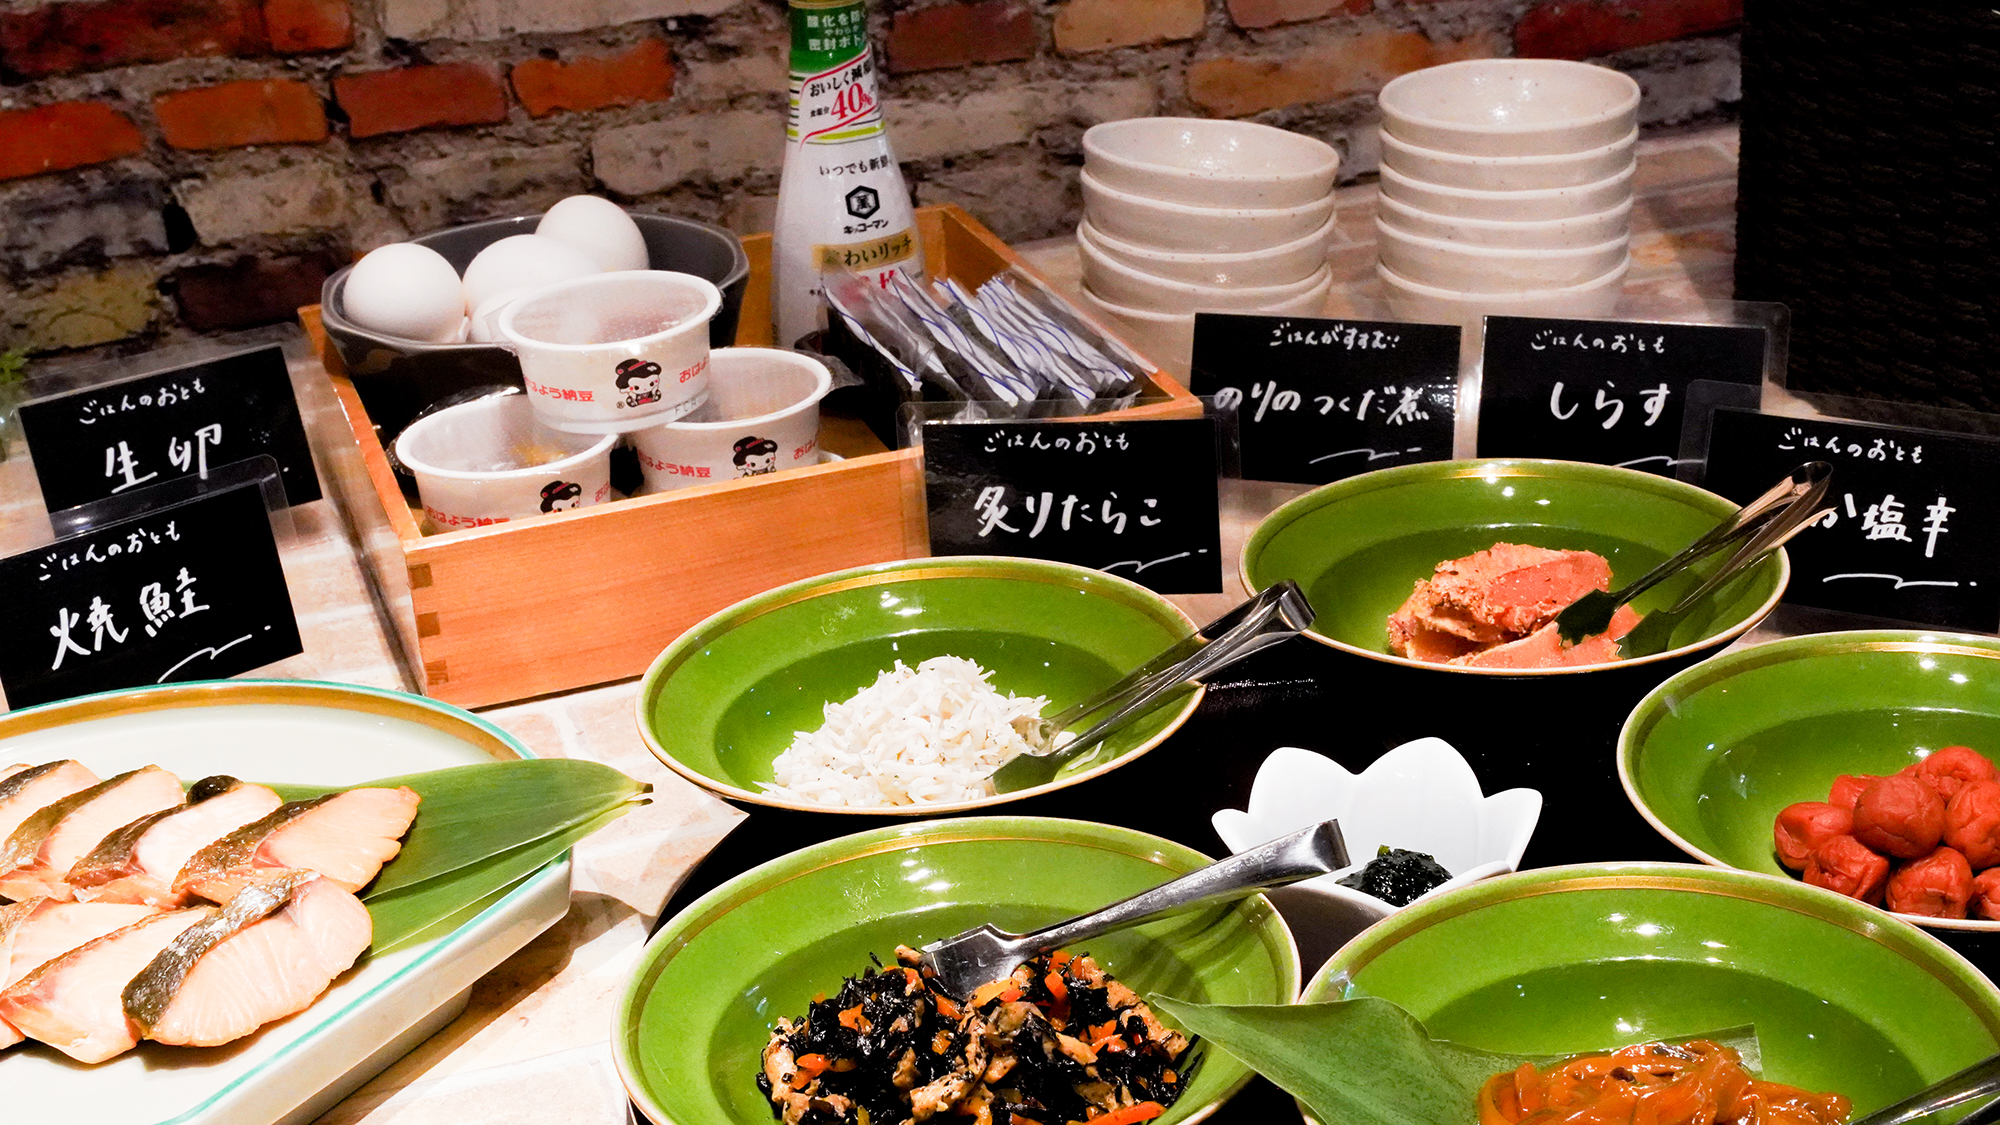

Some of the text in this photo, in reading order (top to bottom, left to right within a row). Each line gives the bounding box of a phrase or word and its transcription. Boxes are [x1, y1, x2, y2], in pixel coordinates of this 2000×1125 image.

[822, 236, 912, 266] わいリッチ
[1531, 329, 1666, 354] ごはんのおとも
[679, 355, 709, 384] おはよ
[79, 378, 205, 424] ごはんのおとも
[524, 375, 596, 403] はよう納豆
[1213, 380, 1430, 426] のりのつくだ煮
[1550, 381, 1671, 429] しらす
[984, 430, 1130, 455] ごはんのおとも
[1778, 427, 1923, 463] ごはんのおとも
[638, 449, 712, 478] はよう納豆
[974, 486, 1162, 539] 炙りたらこ
[39, 521, 180, 581] ごはんのおとも
[50, 567, 210, 670] 焼鮭
